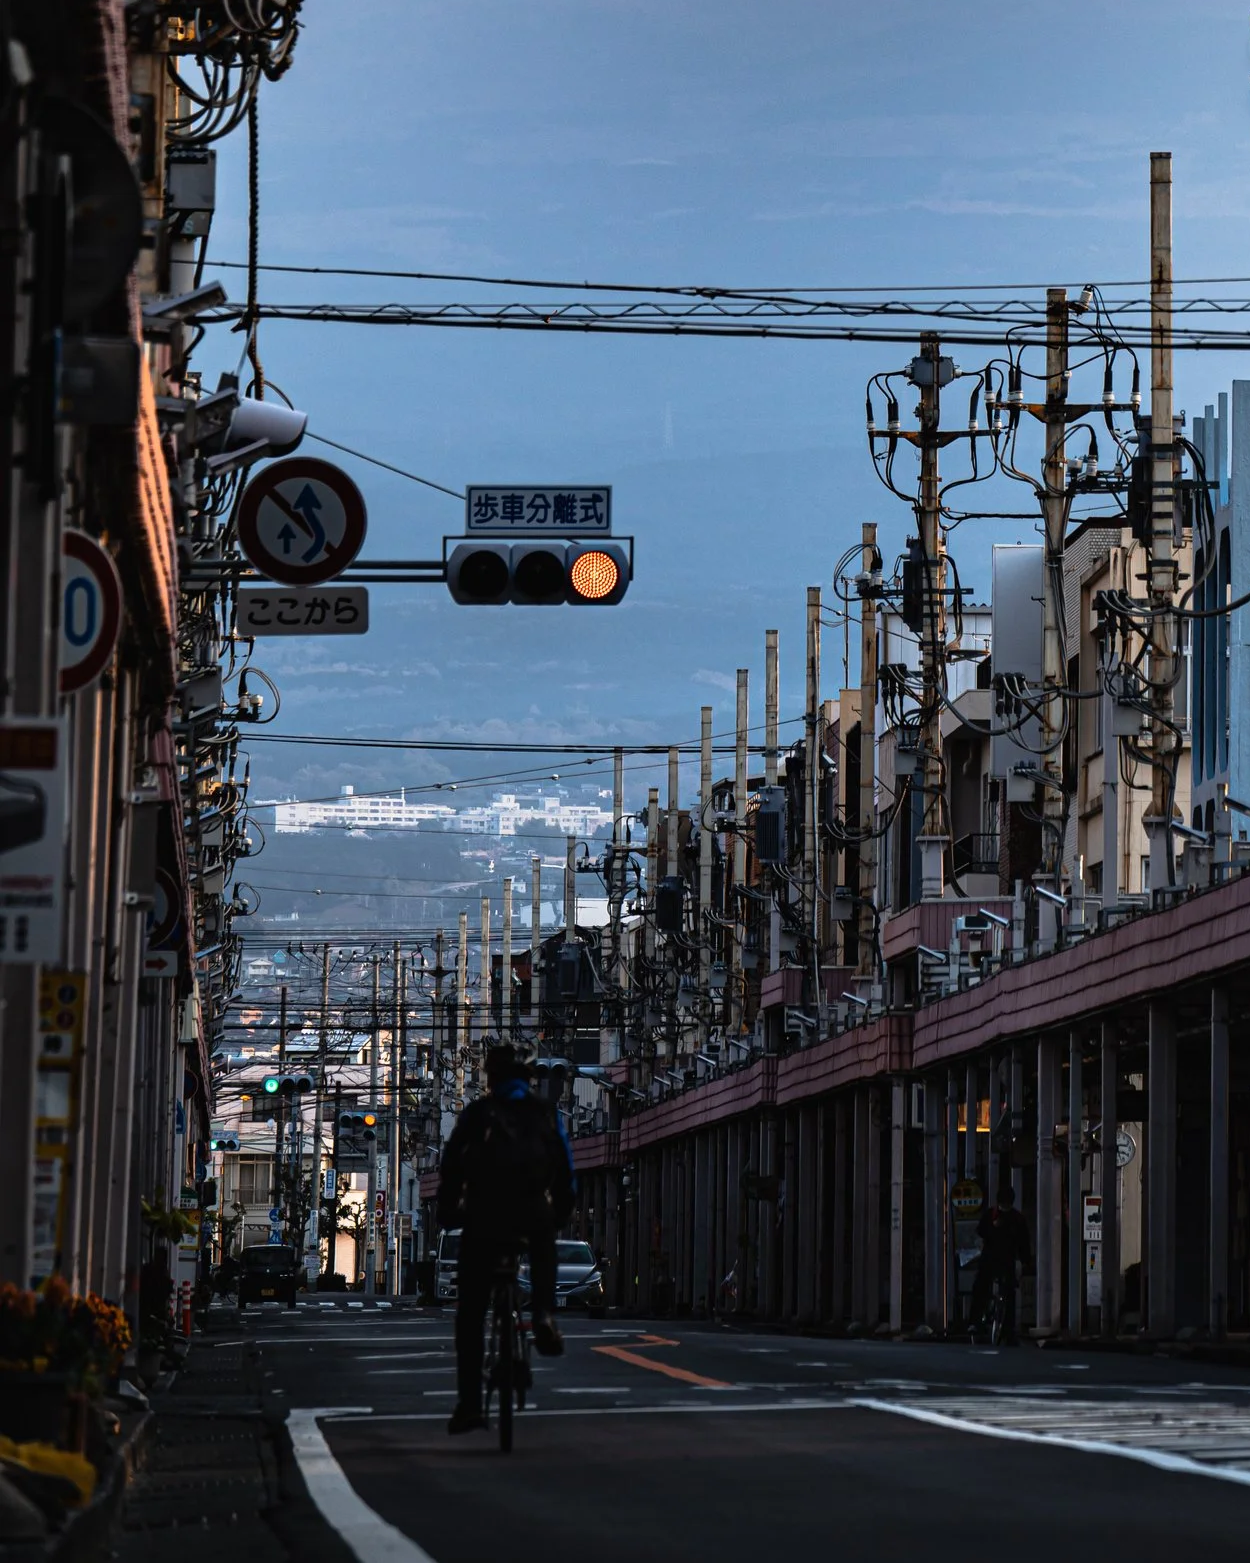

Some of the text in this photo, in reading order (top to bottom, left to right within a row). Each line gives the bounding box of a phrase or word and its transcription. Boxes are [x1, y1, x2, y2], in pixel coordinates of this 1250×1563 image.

[473, 493, 604, 525] 歩車分離式
[248, 597, 360, 626] ここから
